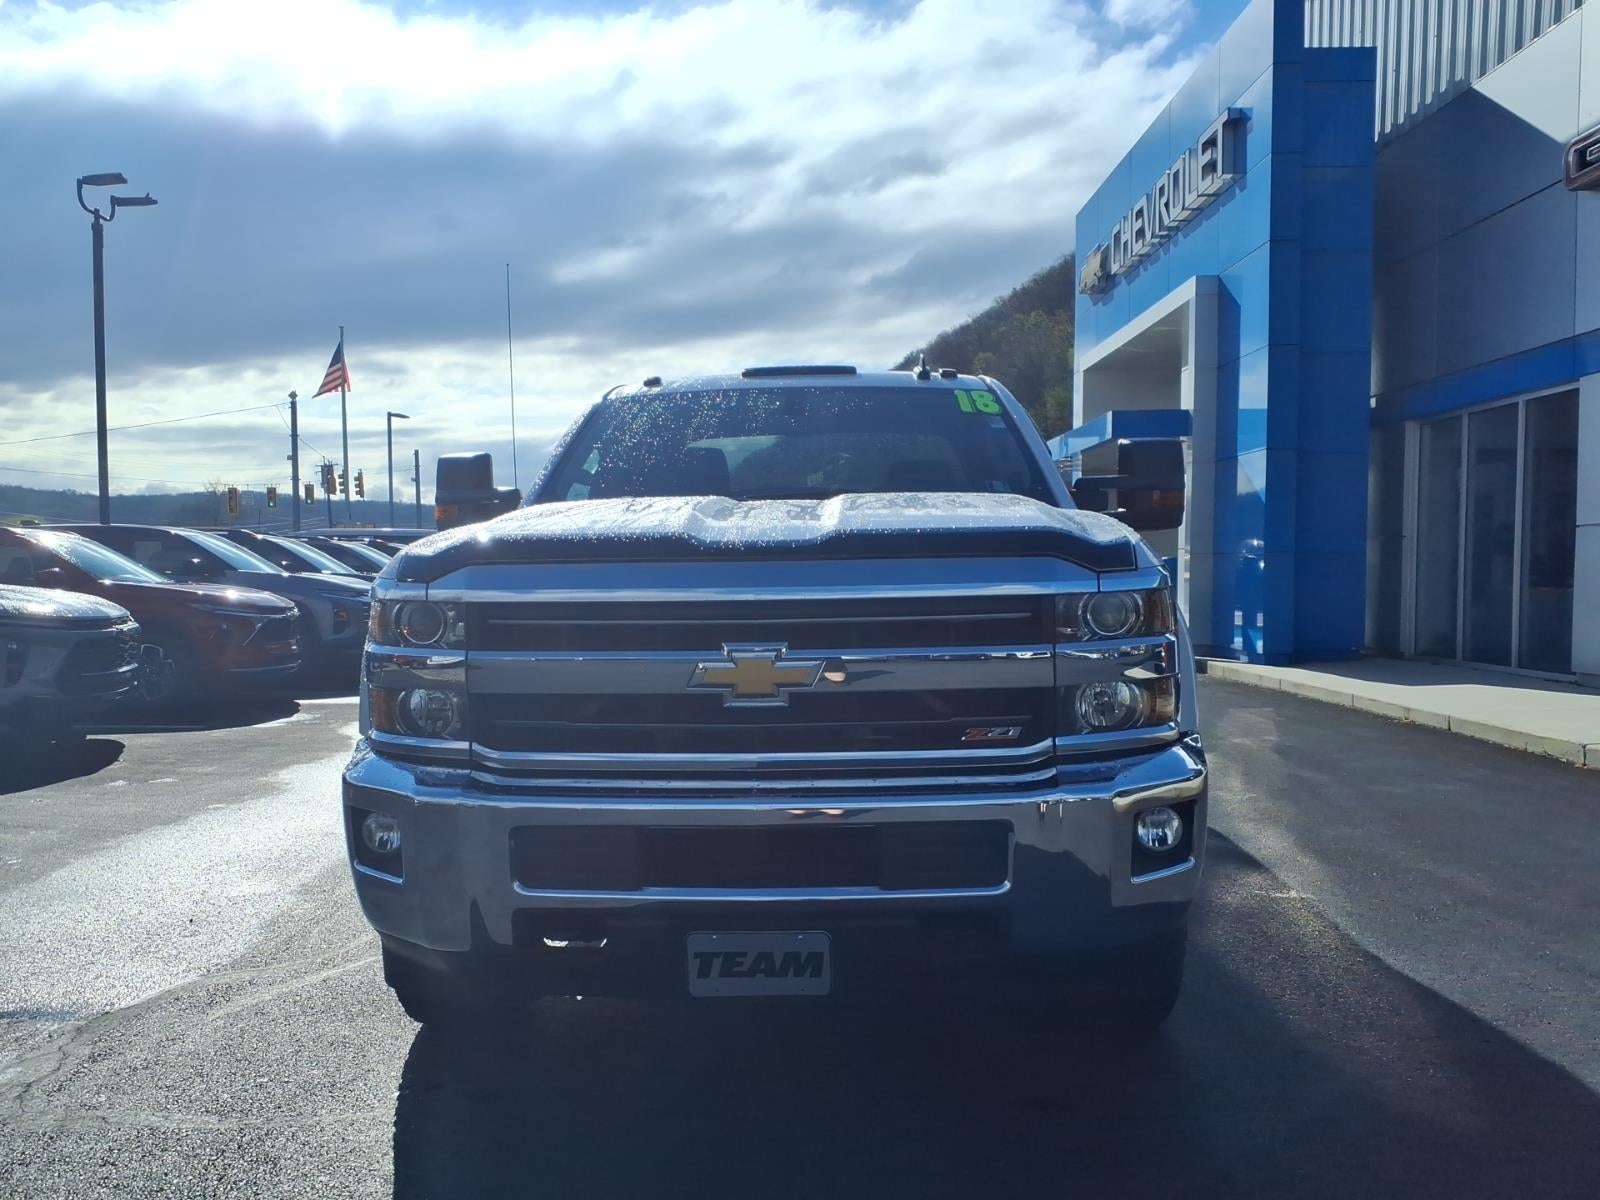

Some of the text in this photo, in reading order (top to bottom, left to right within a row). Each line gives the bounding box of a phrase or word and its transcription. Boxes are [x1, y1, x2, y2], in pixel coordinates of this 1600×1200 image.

[1110, 107, 1248, 275] CHEVROLET
[954, 389, 1001, 415] 18
[693, 951, 825, 979] TEAM
